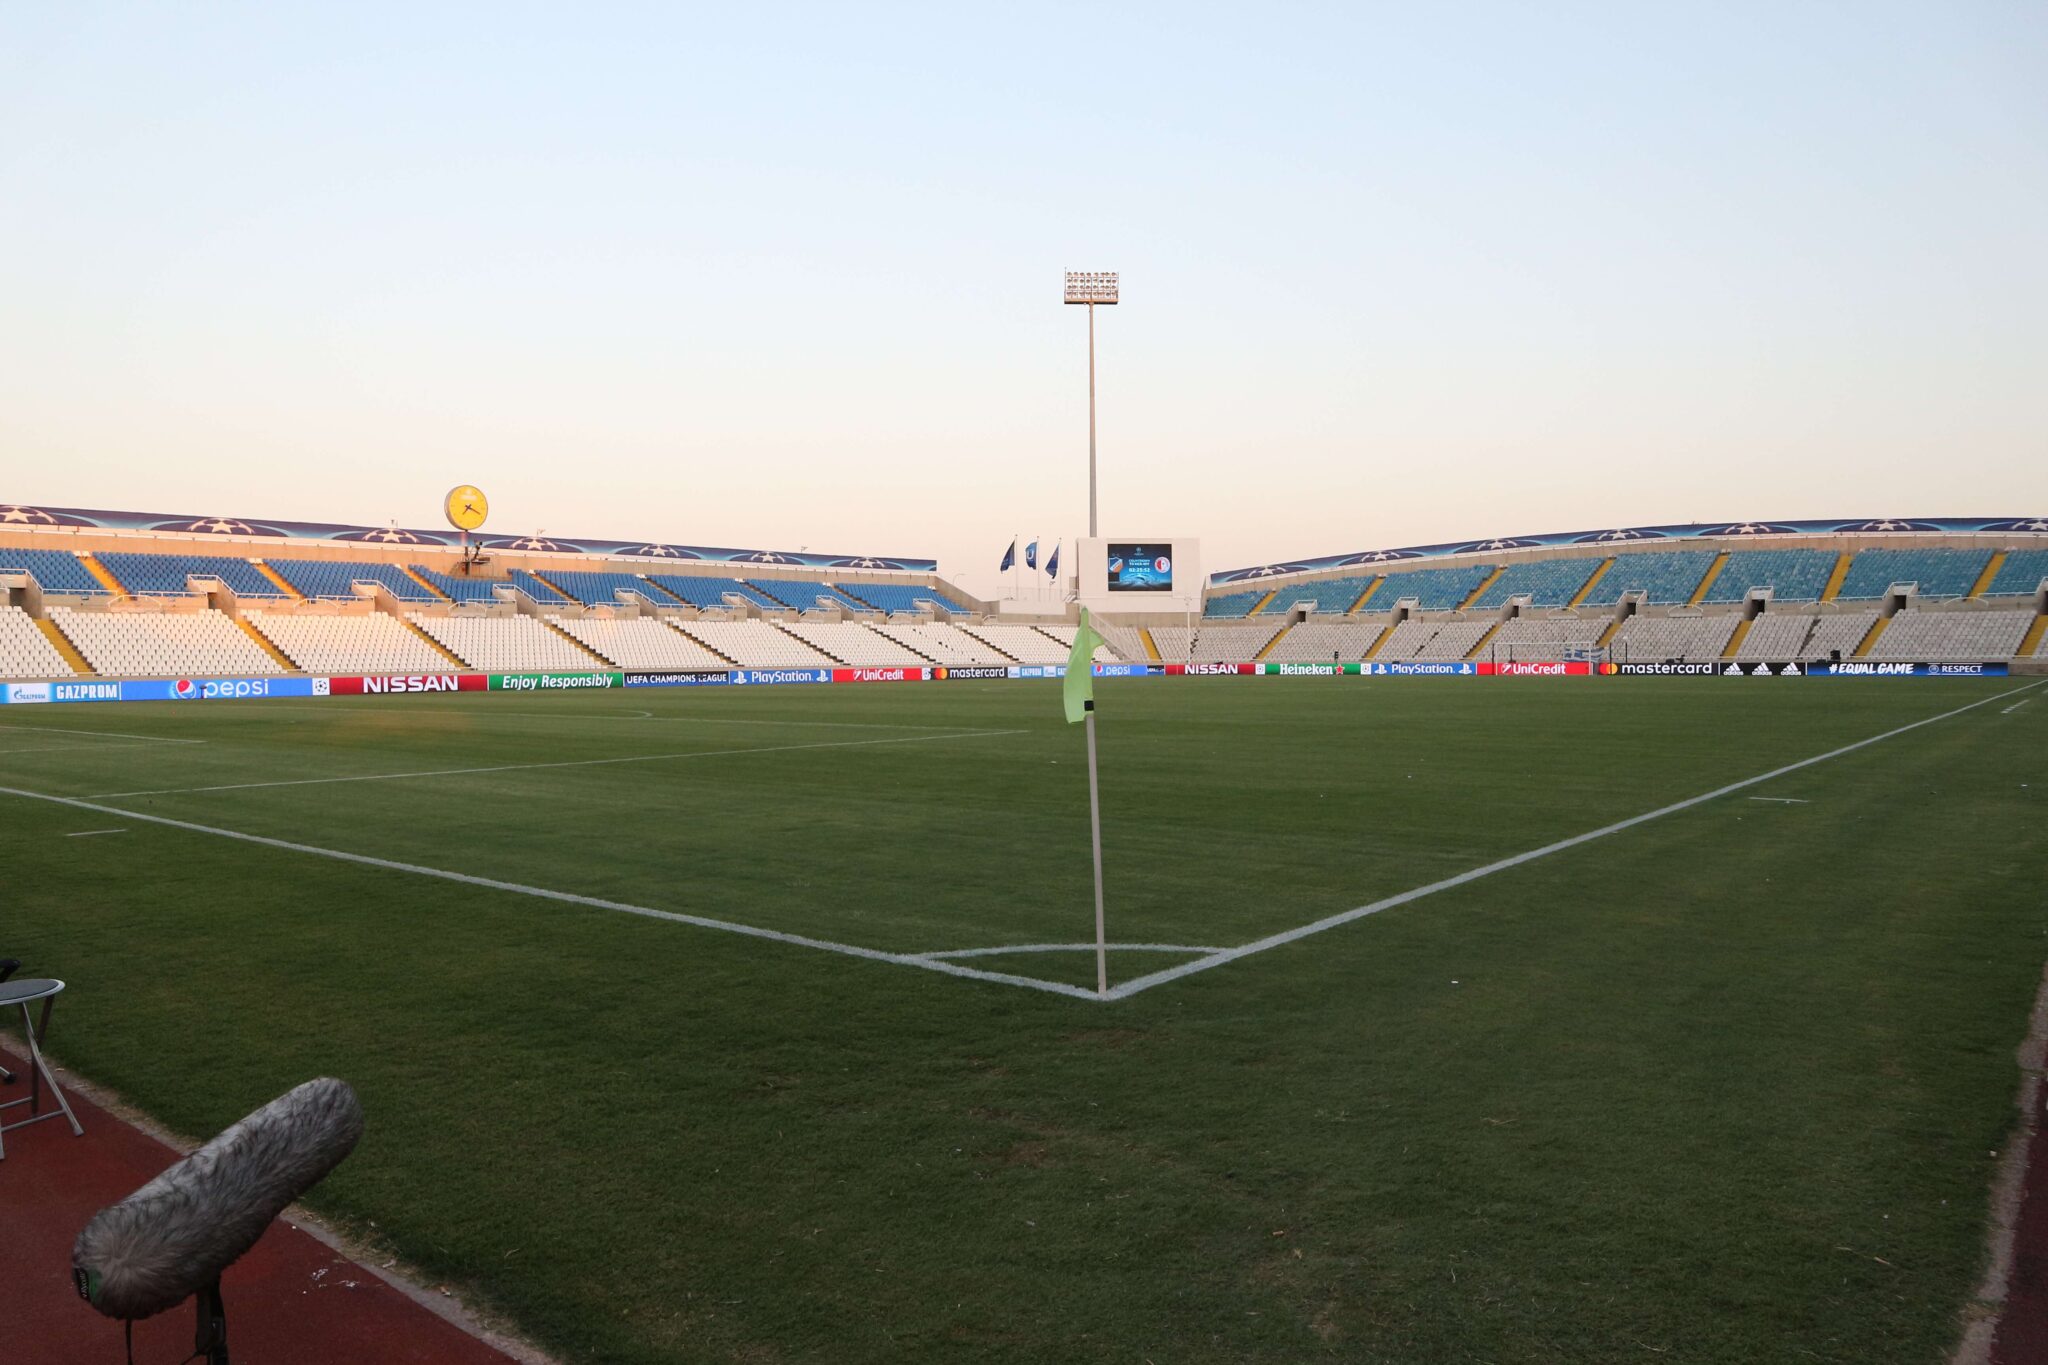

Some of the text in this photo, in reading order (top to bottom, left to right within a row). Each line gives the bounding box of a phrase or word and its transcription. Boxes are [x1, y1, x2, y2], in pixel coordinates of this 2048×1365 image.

[950, 667, 1005, 678] mastercard
[1106, 665, 1130, 676] pepsi
[1185, 664, 1238, 674] NISSAN
[1280, 664, 1333, 674] Heineken
[1514, 663, 1566, 674] UniCredit
[1621, 662, 1712, 674] mastercard
[1942, 665, 1982, 673] RESPECT
[626, 676, 648, 684] UEFA
[650, 674, 696, 684] CHAMPIONS
[862, 668, 904, 680] UniCredit
[363, 676, 458, 692] NISSAN
[503, 674, 613, 690] Enjoy Responsibly
[56, 684, 118, 700] GAZPROM
[204, 679, 268, 698] pepsi
